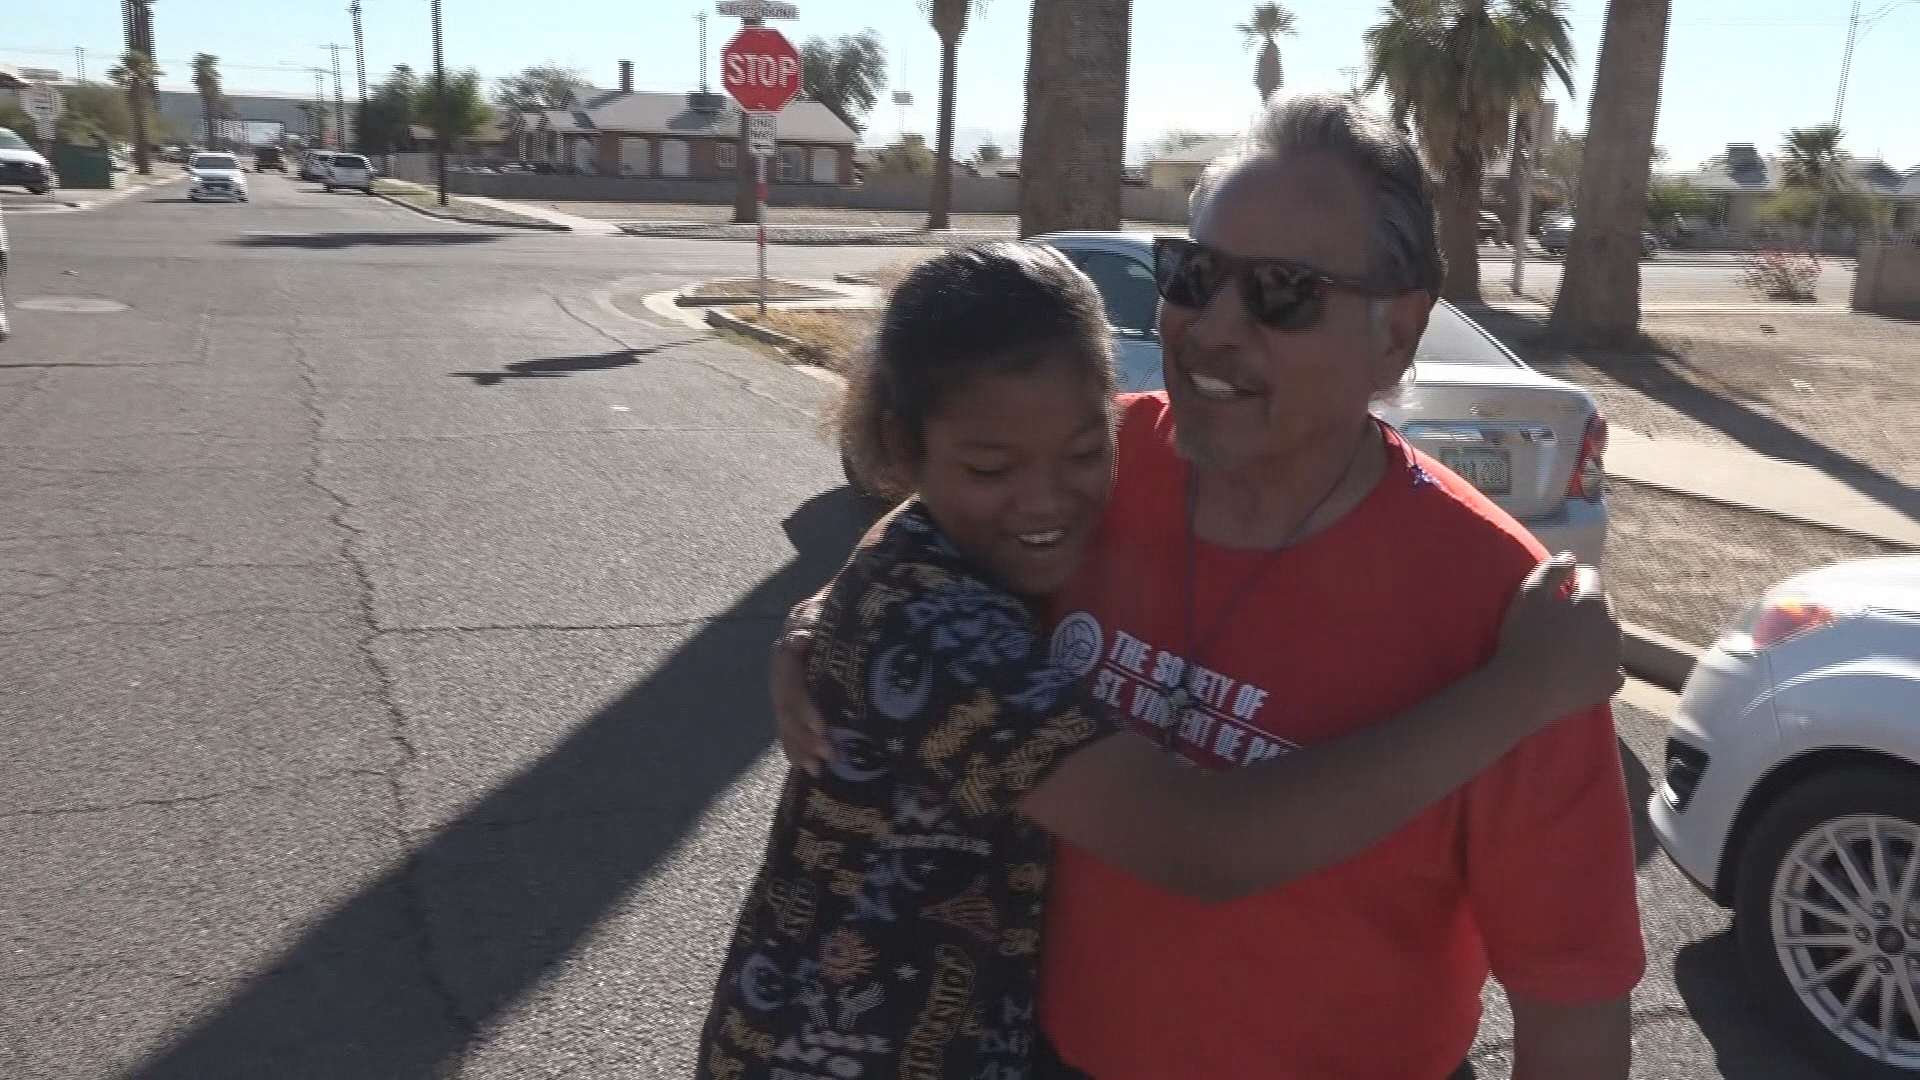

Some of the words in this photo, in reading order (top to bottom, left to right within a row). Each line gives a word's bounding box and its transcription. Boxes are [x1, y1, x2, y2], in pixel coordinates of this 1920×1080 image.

[723, 4, 791, 20] JEFFERSON
[726, 52, 798, 88] STOP
[750, 117, 773, 128] ONE
[750, 129, 773, 140] WAY
[1110, 630, 1152, 674] THE
[1151, 650, 1236, 709] SOIETY
[1232, 683, 1270, 720] OF
[1130, 684, 1216, 748] VINENT
[1213, 723, 1247, 761] DE
[803, 1023, 892, 1054] LOOK
